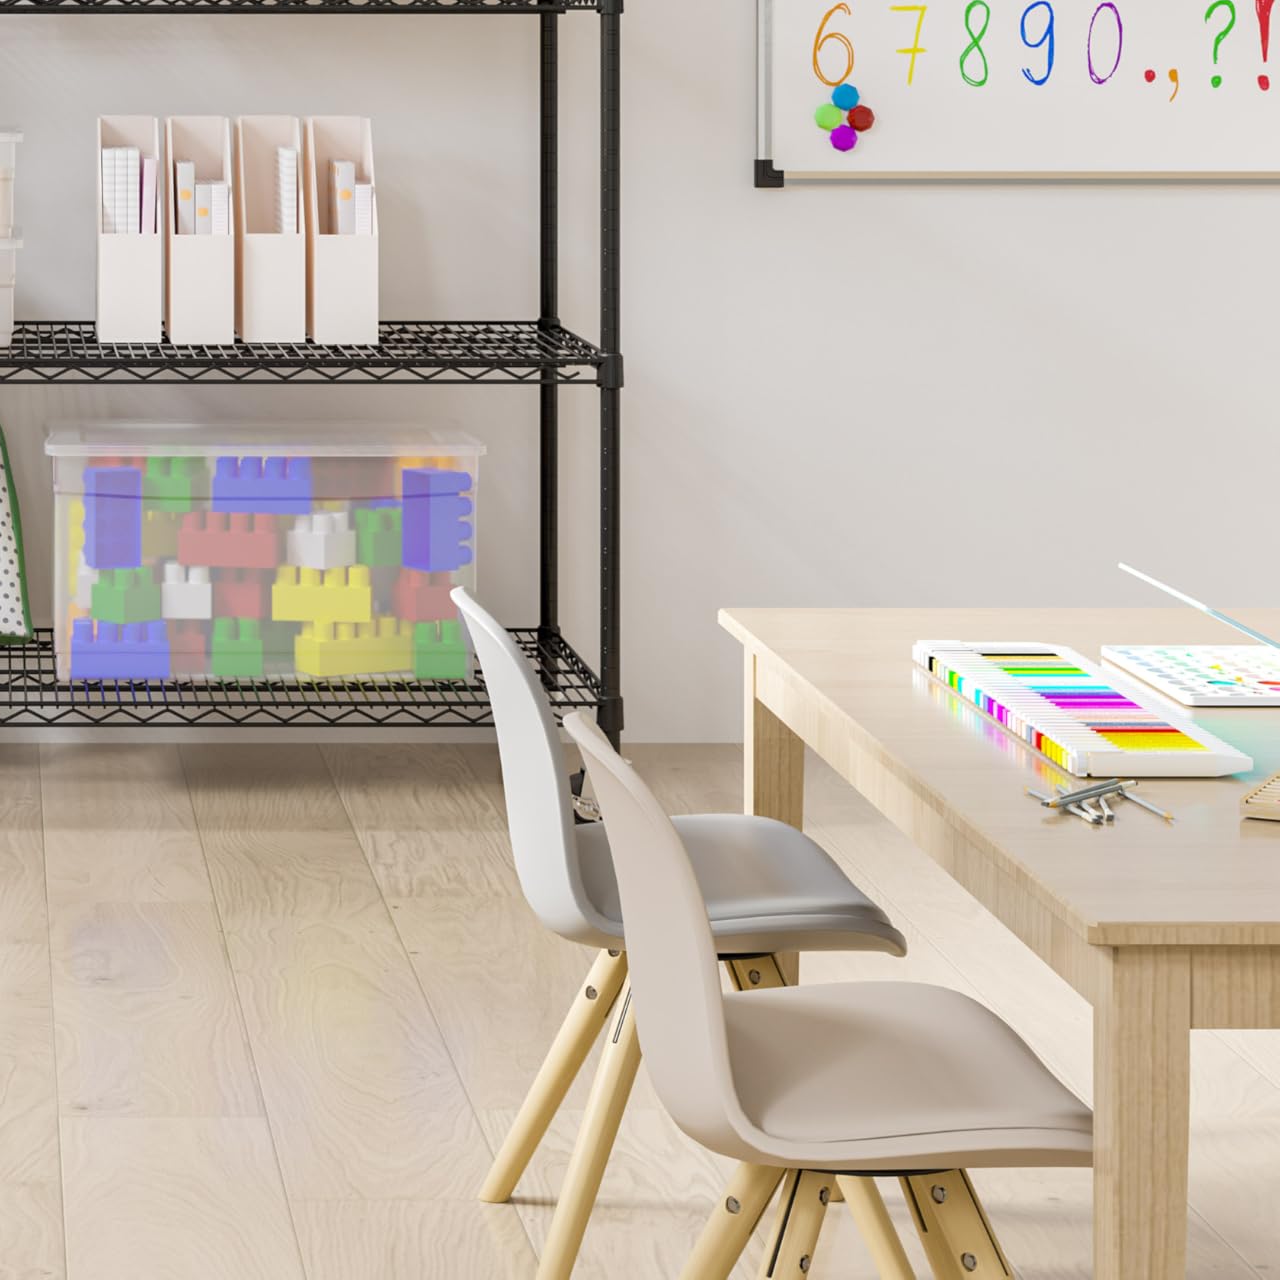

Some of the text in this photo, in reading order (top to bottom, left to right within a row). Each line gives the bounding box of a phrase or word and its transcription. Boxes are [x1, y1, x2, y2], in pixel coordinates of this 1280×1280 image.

[812, 2, 855, 87] 6
[888, 4, 928, 87] 7
[959, 0, 991, 87] 8
[1020, 0, 1056, 86] 9
